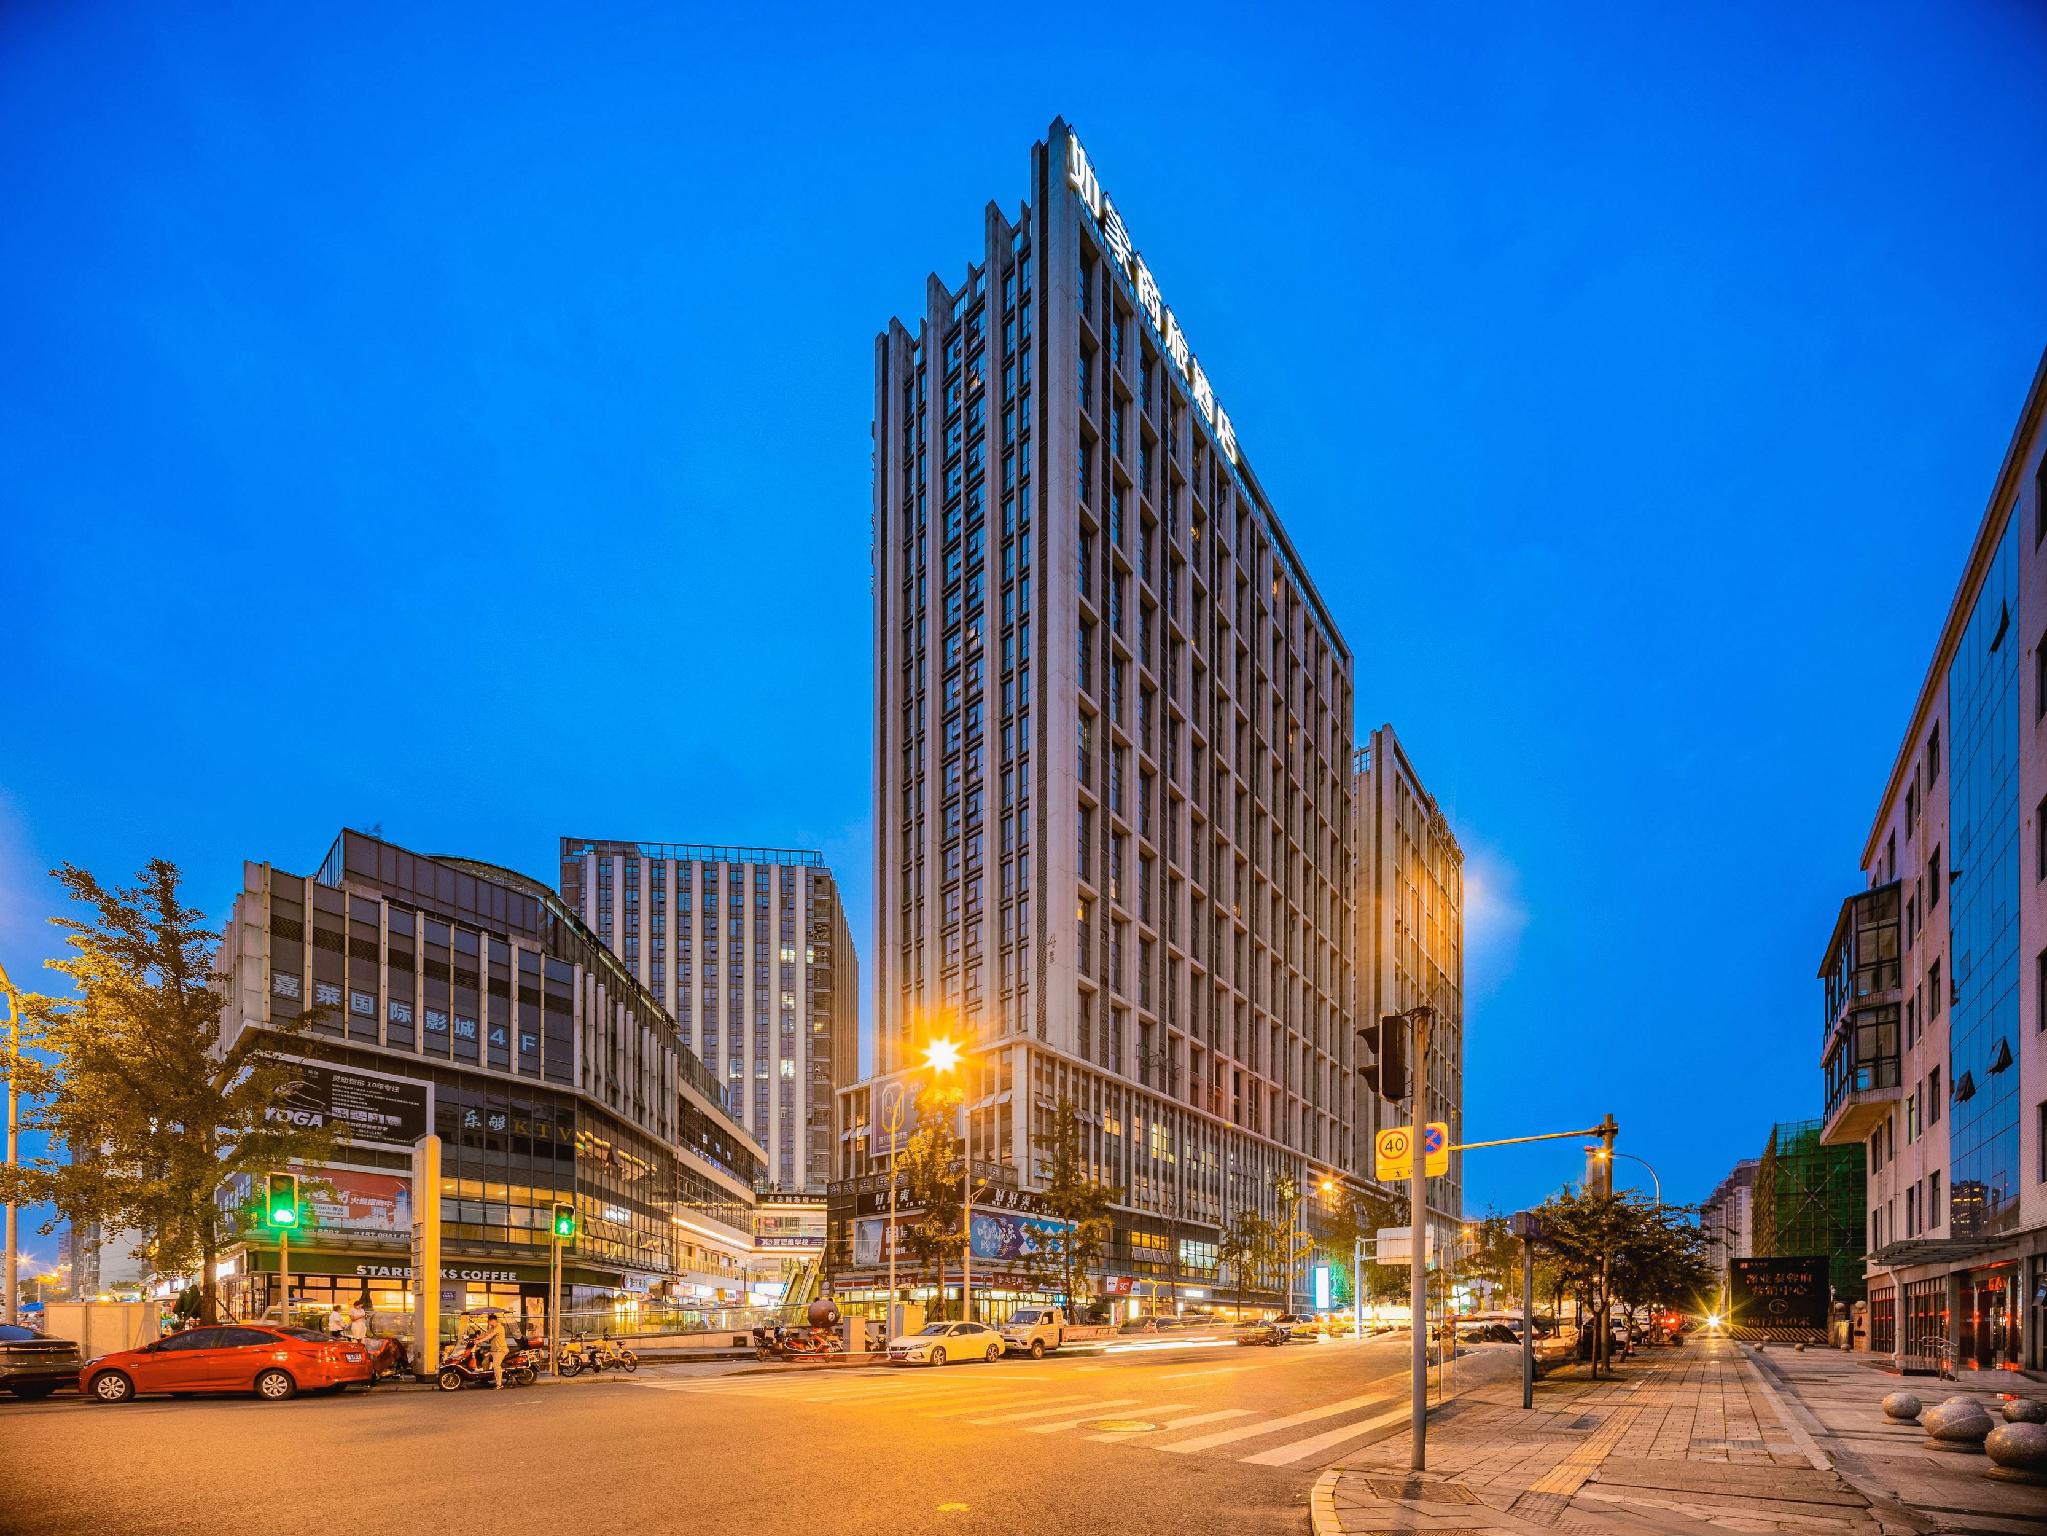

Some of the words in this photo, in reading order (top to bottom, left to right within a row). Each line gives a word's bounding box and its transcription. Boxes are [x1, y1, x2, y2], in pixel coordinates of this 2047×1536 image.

[273, 973, 476, 1040] 嘉莱国际影城
[490, 1028, 537, 1052] 4F
[264, 1106, 324, 1128] YOGA
[513, 1120, 573, 1141] KTV
[1384, 1138, 1404, 1153] 40
[356, 1265, 457, 1279] STARBKS
[461, 1270, 517, 1281] COFFEE
